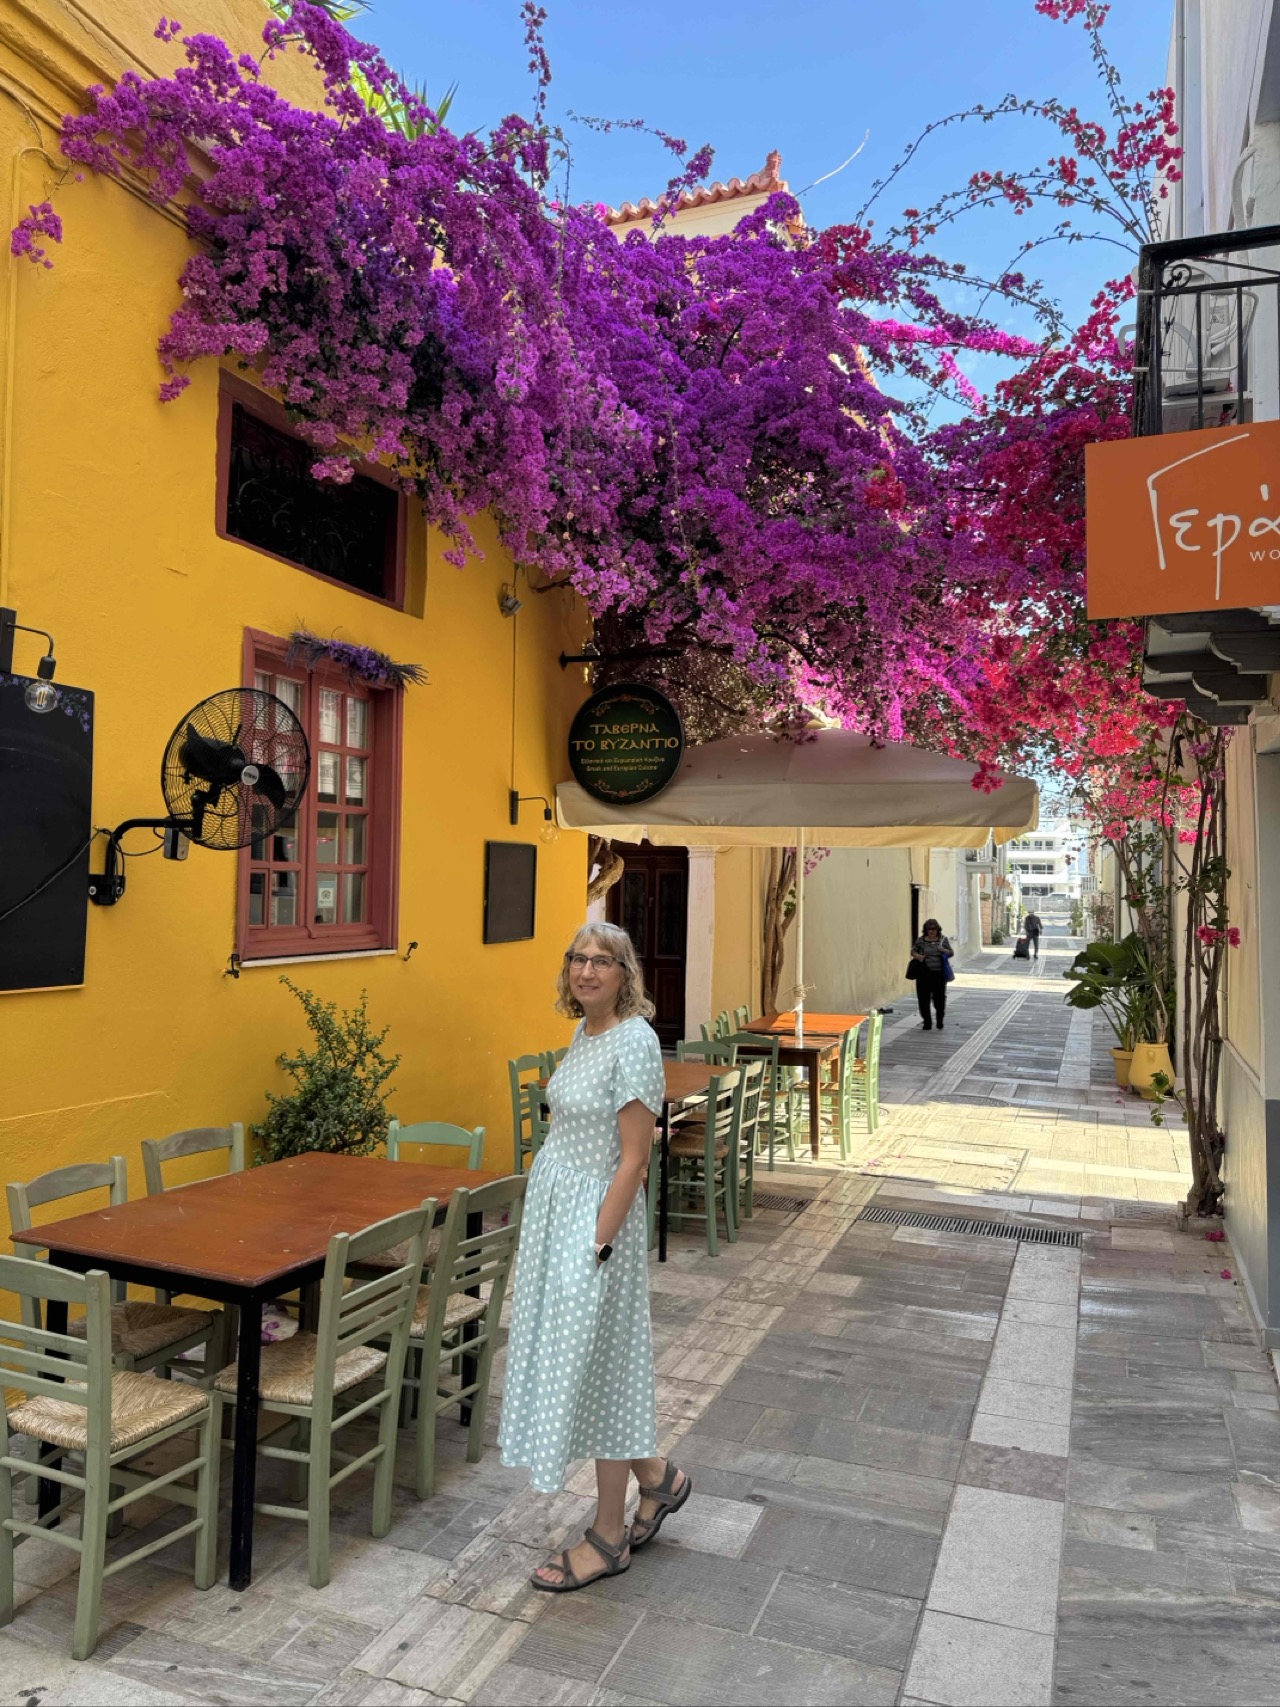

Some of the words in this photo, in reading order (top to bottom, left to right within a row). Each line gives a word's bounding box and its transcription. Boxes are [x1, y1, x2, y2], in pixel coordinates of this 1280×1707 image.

[590, 723, 660, 734] ΤΑΒΕΡΝΑ
[571, 739, 595, 751] ΤΟ
[600, 737, 679, 750] ΒΥΖΑΝΤΙΟ
